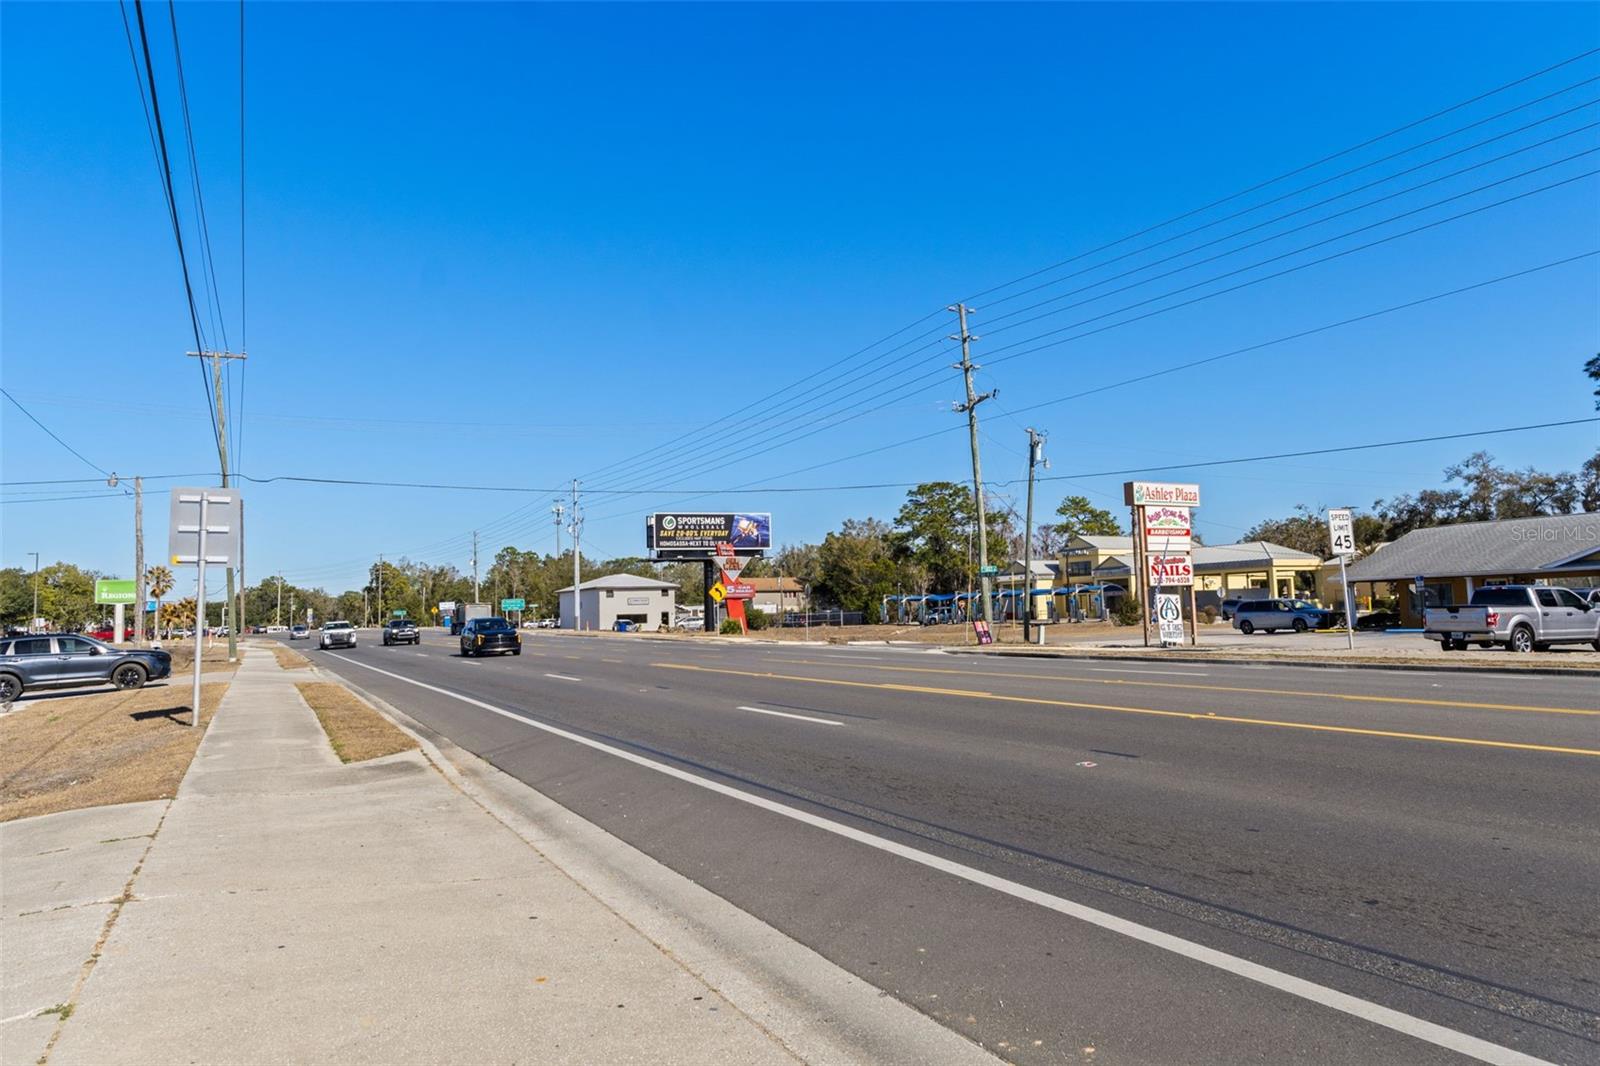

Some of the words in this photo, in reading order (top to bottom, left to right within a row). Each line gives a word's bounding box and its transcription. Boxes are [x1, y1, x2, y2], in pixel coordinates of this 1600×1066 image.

[1145, 486, 1173, 502] Ashley
[1175, 488, 1198, 502] Plaza
[677, 517, 725, 525] SPORTSMANS
[1331, 513, 1350, 521] SPEED
[1333, 524, 1349, 532] LIMIT
[1334, 535, 1352, 549] 45
[1151, 565, 1191, 576] NAILS
